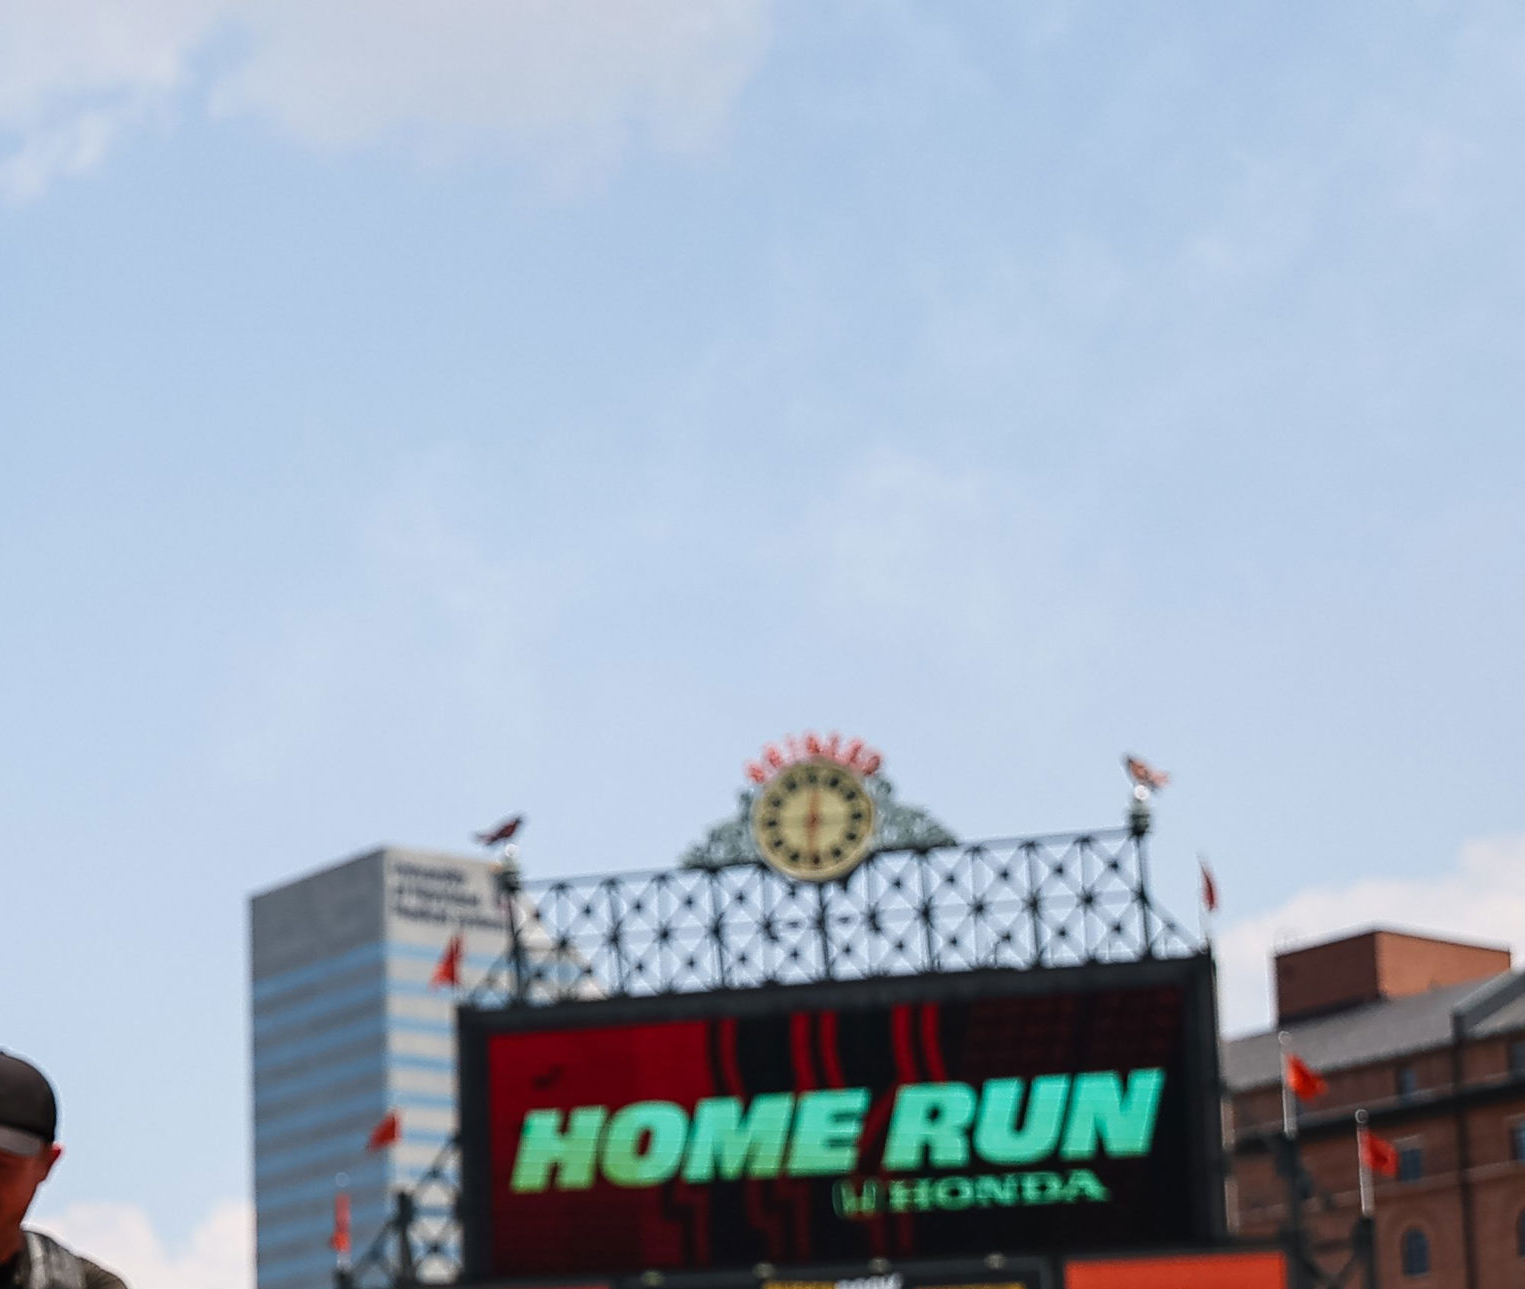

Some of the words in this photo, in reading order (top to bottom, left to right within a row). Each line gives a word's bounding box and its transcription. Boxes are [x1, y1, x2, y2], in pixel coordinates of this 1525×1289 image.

[510, 1087, 869, 1193] HOME
[883, 1068, 1162, 1170] RUN
[887, 1168, 1110, 1214] HONDA
